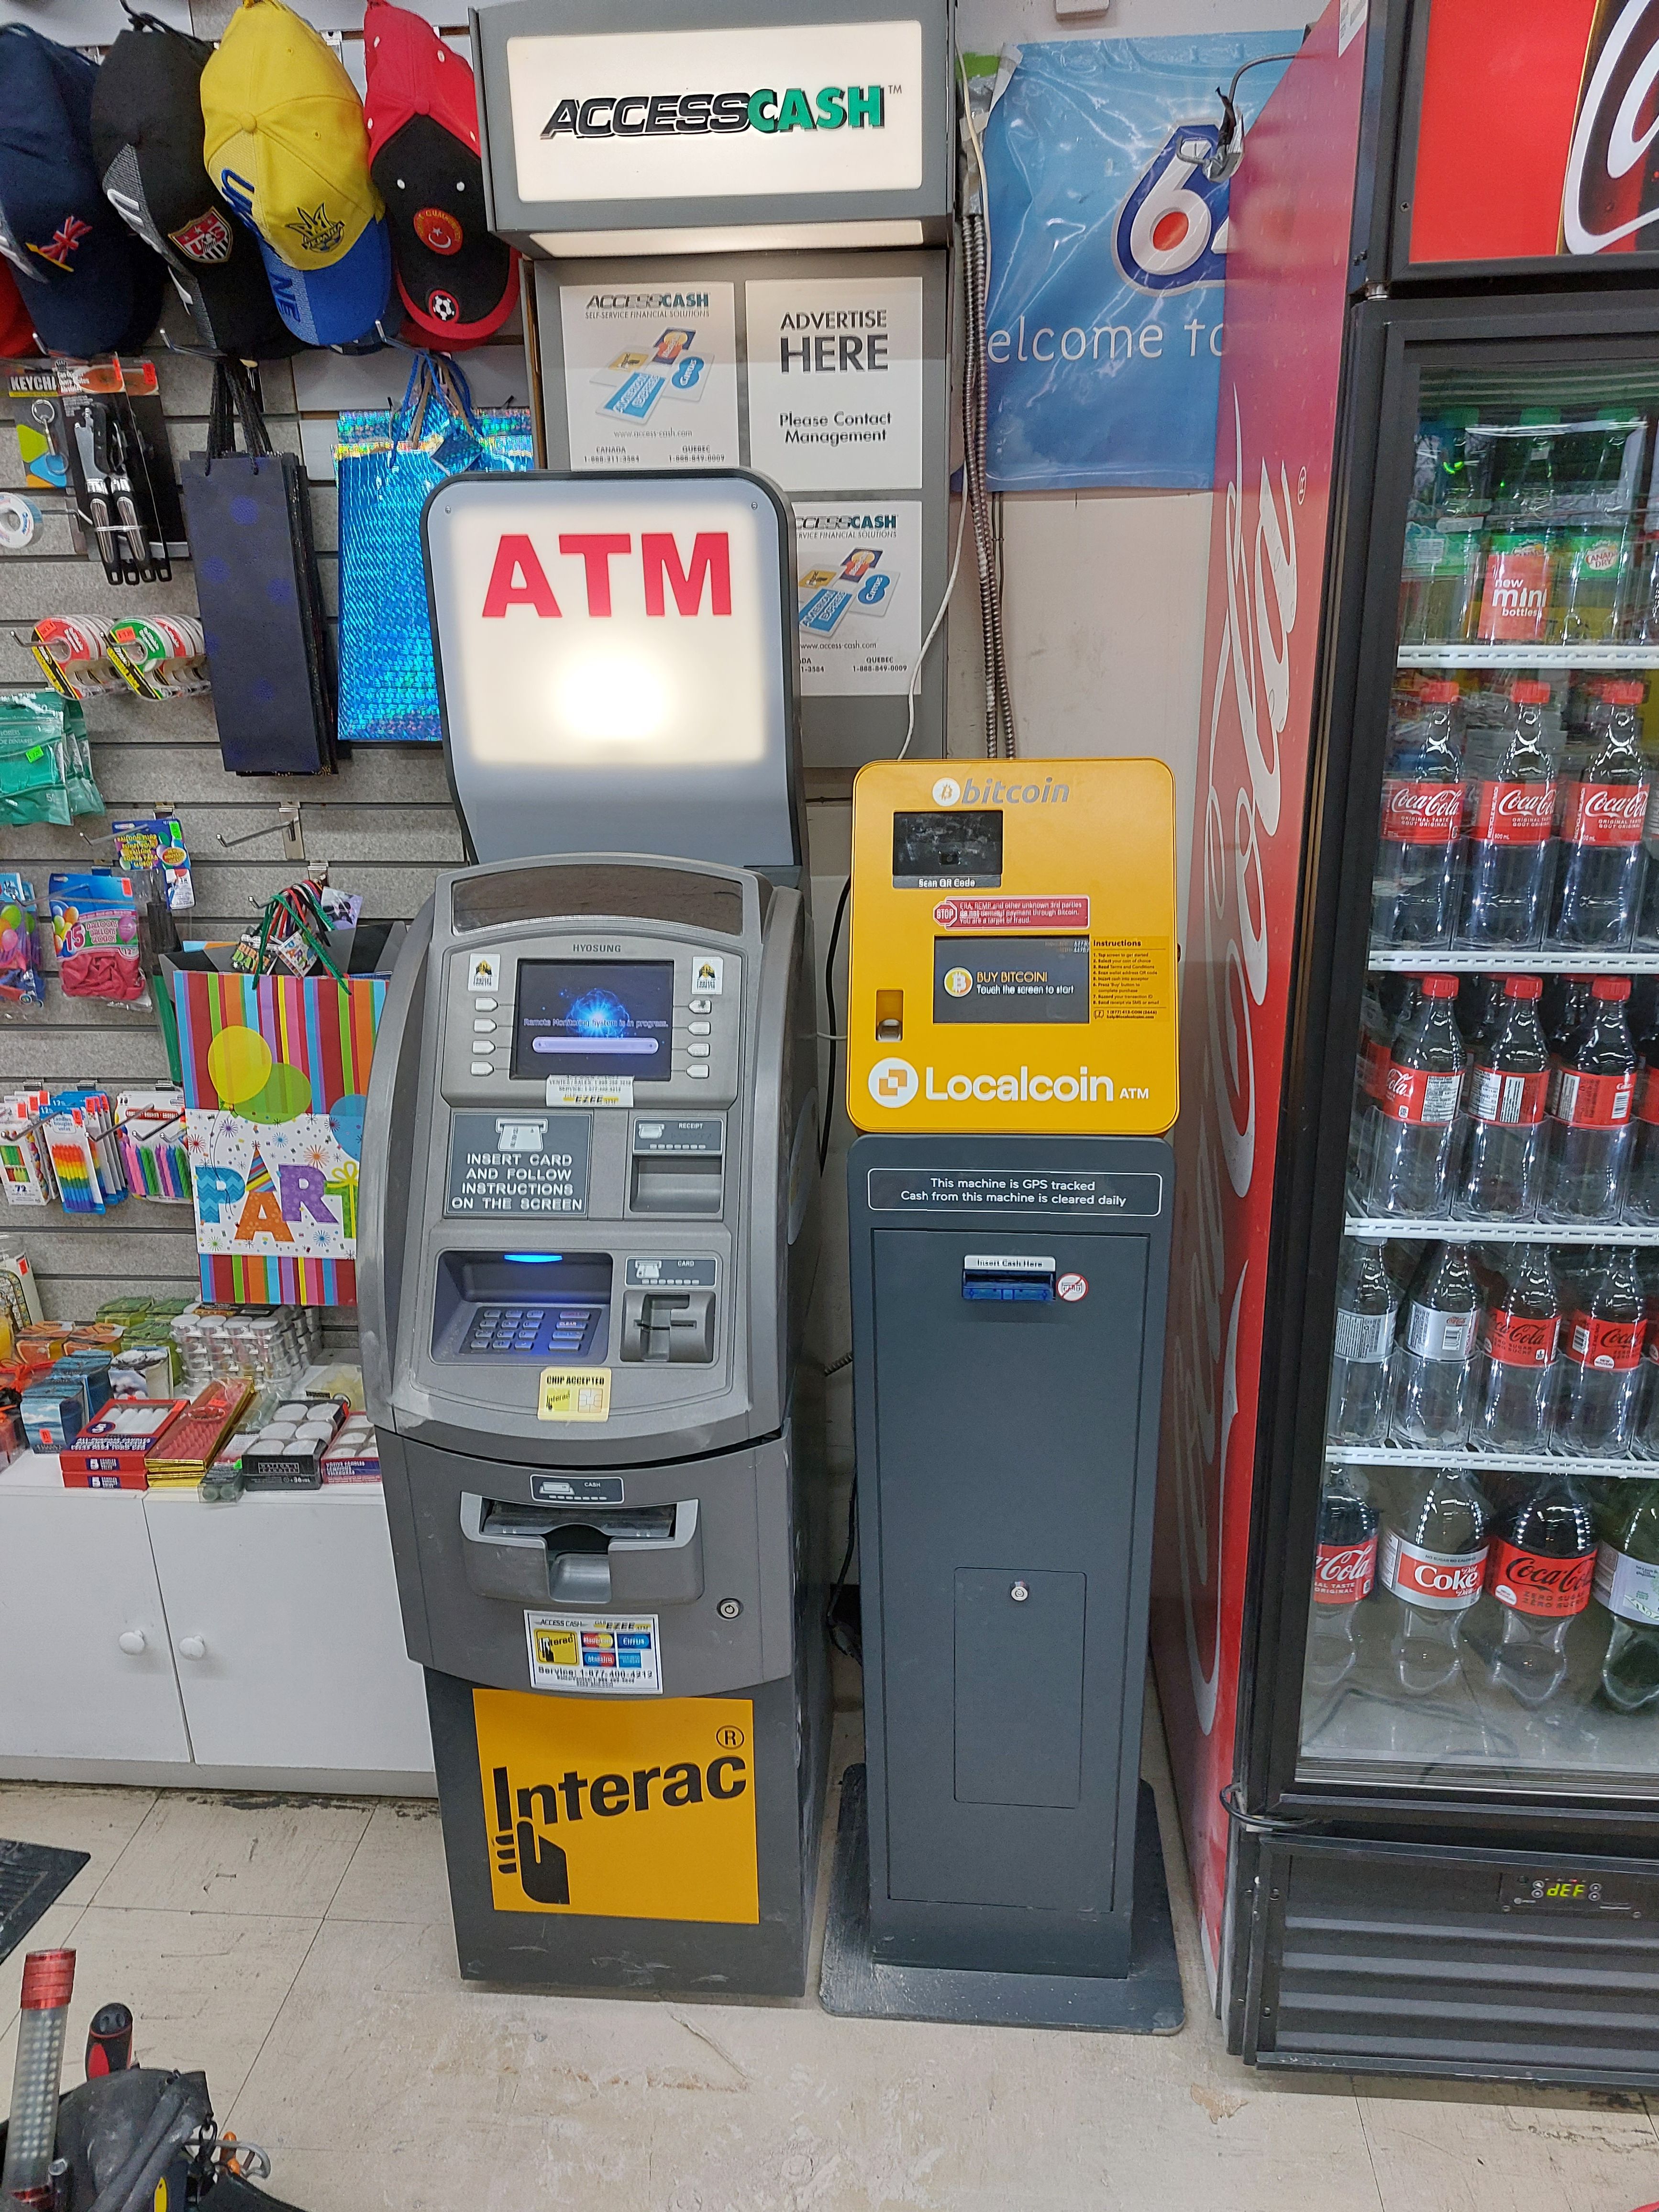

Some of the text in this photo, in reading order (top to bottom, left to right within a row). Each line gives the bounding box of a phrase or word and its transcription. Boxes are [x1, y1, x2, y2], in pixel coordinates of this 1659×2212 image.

[540, 83, 884, 140] ACCESSCASH
[630, 310, 667, 319] FINANCIAL
[780, 310, 887, 331] ADVERTISE
[780, 333, 888, 374] HERE
[780, 411, 891, 428] Please Contact
[785, 428, 886, 448] Management
[596, 444, 711, 454] CANADA QUEBEC
[819, 530, 897, 539] FINANCIAL SOLUTIONS
[482, 532, 732, 617] ATM
[801, 640, 877, 650] www.access-cash.com
[961, 776, 1070, 805] bitcoin
[1391, 788, 1462, 816] Coca-Cola
[918, 877, 975, 888] Scan QR Code
[1062, 902, 1082, 911] parties
[936, 908, 953, 920] STOP
[1006, 909, 1032, 918] payment
[1033, 909, 1056, 918] through
[65, 925, 85, 952] 15
[573, 944, 621, 953] HYOSUNG
[976, 972, 998, 983] BUY
[976, 984, 1074, 995] Touch the screen to start
[524, 1018, 551, 1028] Remote
[619, 1019, 625, 1027] is
[627, 1019, 634, 1027] in
[926, 1066, 1149, 1102] Localcoin ATM
[467, 1153, 573, 1166] INSERT CARD
[466, 1167, 572, 1181] AND FOLLOW
[462, 1182, 574, 1196] INSTRUCTIONS
[930, 1178, 1095, 1191] This machine is GPS tracked
[451, 1197, 582, 1211] ON THE SCREEN
[901, 1190, 1127, 1207] Cash from this machine is cleared daily
[977, 1258, 1042, 1268] Insert Cash Here
[546, 1375, 605, 1386] CHIP ACCEPTED
[1414, 1565, 1479, 1592] Coke
[493, 1755, 747, 1831] Interac
